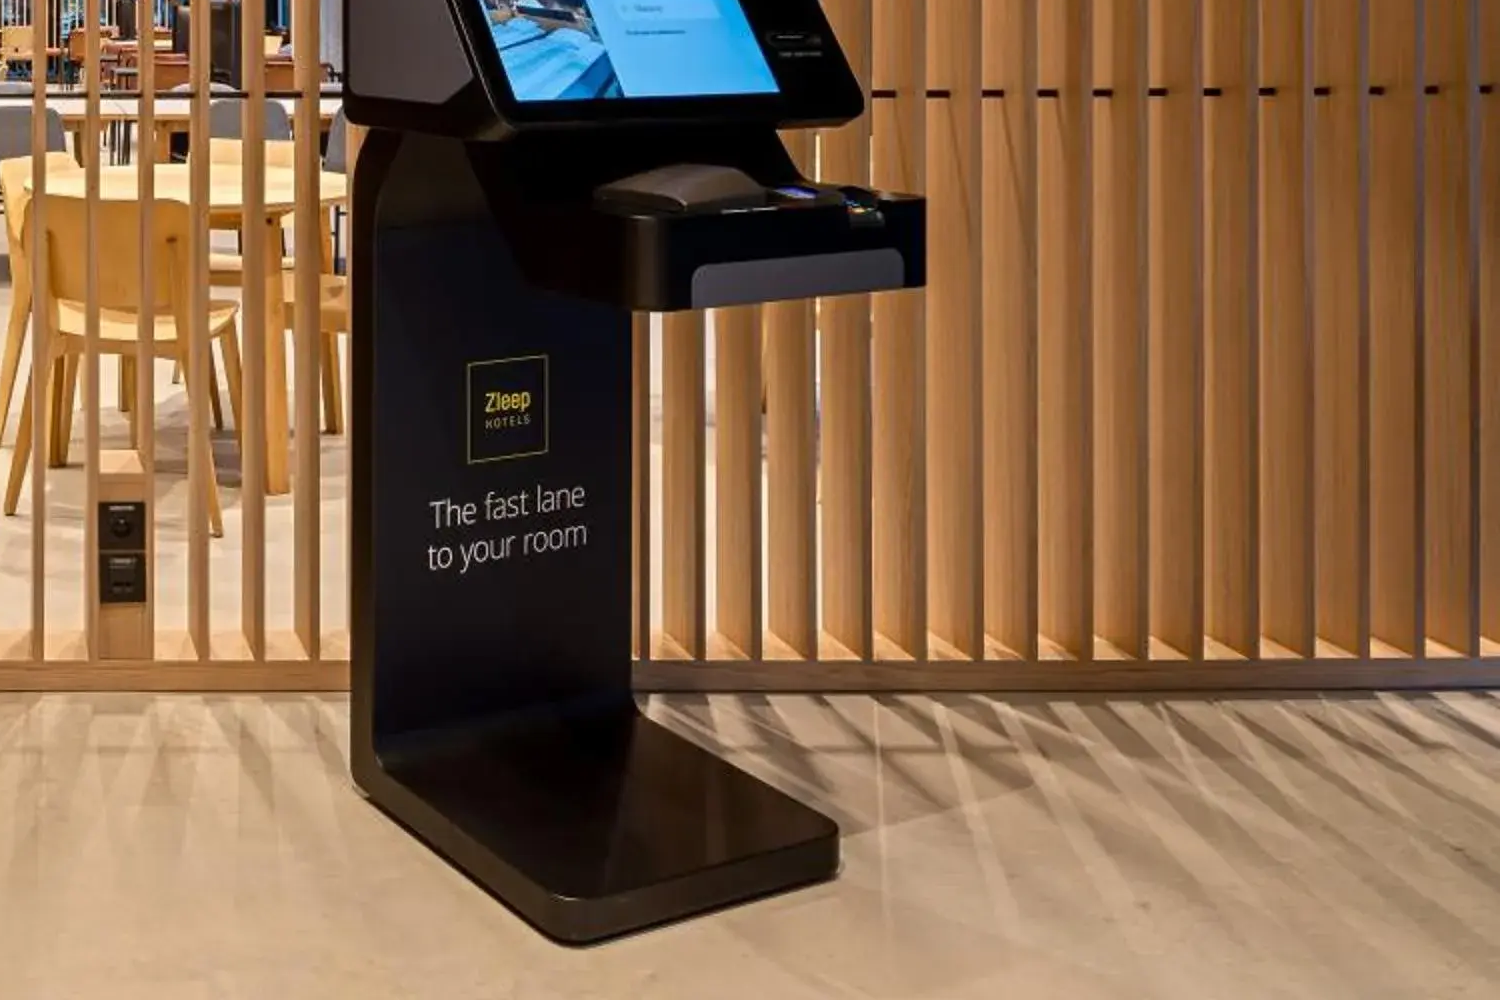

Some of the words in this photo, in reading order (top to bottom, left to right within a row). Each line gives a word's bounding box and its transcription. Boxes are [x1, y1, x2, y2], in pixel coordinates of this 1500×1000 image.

[485, 391, 532, 413] Zleep
[485, 413, 531, 430] HOTELS
[429, 497, 477, 529] The
[484, 490, 529, 521] fast
[536, 484, 586, 513] lane
[427, 544, 453, 571] to
[459, 534, 516, 574] your
[522, 524, 588, 556] room
